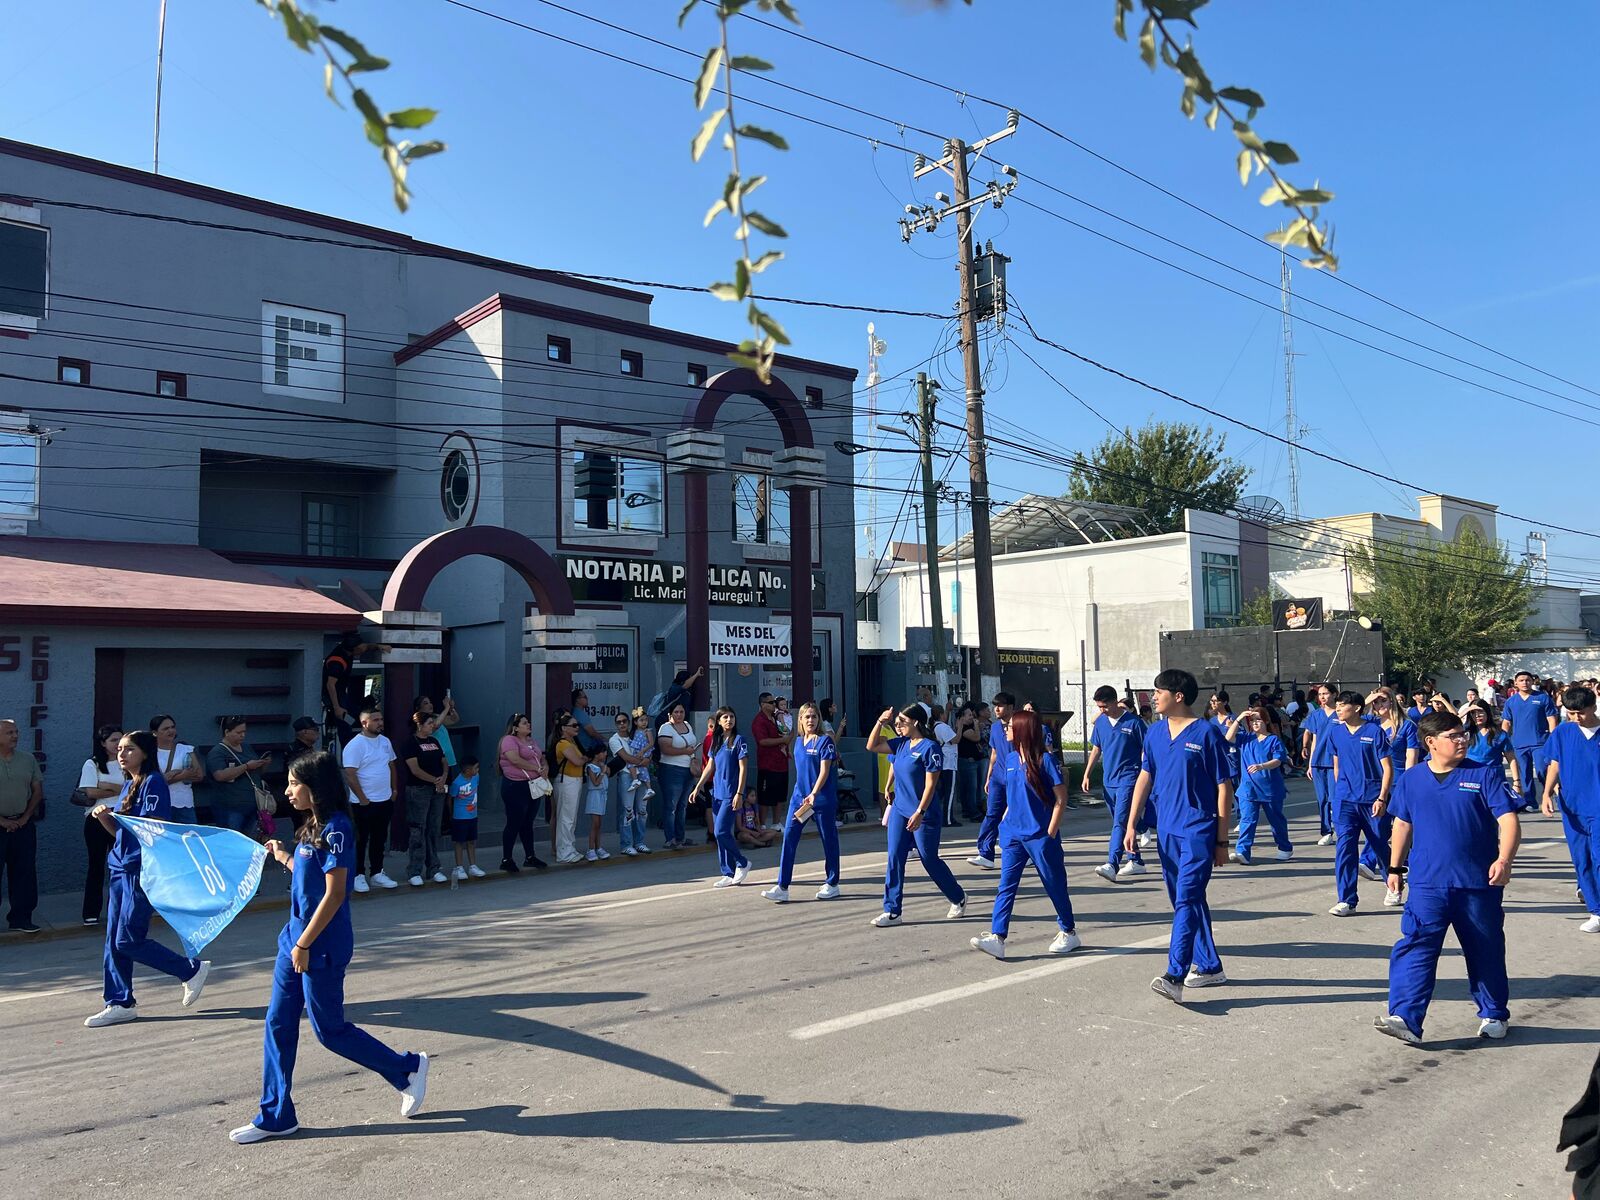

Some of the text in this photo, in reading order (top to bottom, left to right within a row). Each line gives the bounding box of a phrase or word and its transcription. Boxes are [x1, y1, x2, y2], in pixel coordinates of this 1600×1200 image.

[567, 559, 664, 582] NOTARIA
[672, 565, 752, 587] PLICA
[759, 571, 787, 589] No.
[634, 585, 654, 599] Lic.
[658, 586, 687, 600] Mari
[756, 591, 765, 603] T.
[726, 625, 775, 640] MES DEL
[711, 642, 789, 657] TESTAMENTO
[999, 653, 1055, 665] EKOBURGER
[573, 680, 597, 690] arissa
